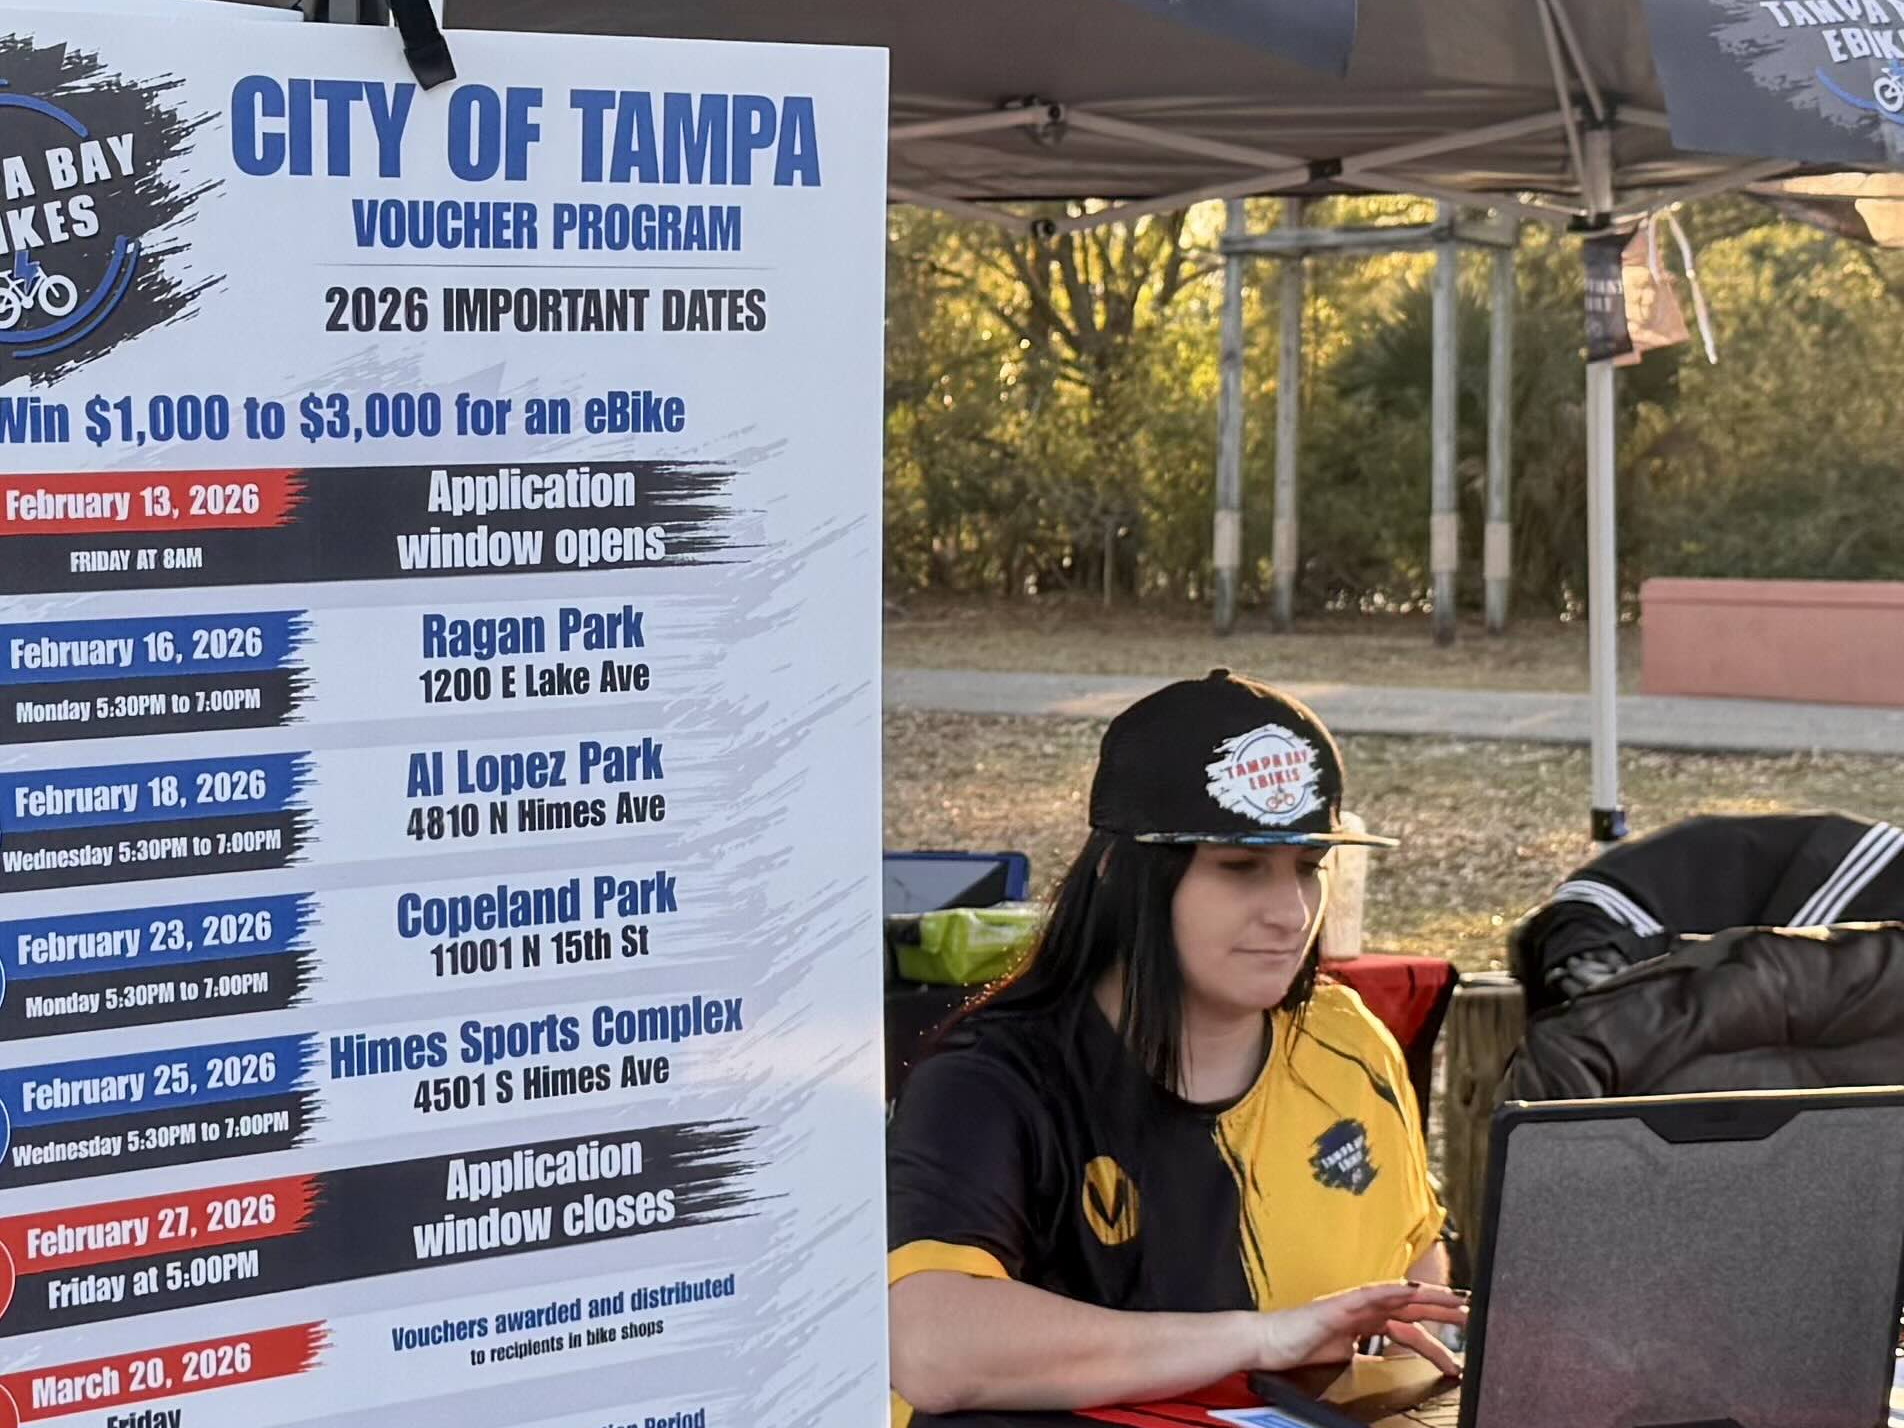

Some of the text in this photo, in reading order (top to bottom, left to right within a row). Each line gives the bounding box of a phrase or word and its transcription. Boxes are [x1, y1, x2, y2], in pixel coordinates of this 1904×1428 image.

[231, 74, 822, 187] CITY OF TAMPA
[45, 134, 135, 191] BAY
[352, 198, 742, 252] VOUCHER PROGRAM
[324, 286, 767, 333] 2026 IMPORTANT DATES
[83, 394, 230, 448] $1,000
[242, 395, 286, 441] to
[299, 390, 438, 444] $3,000
[454, 391, 513, 436] for
[524, 397, 571, 435] an
[584, 389, 686, 435] eBike
[6, 483, 260, 523] February 13, 2026
[427, 468, 635, 516] Application
[69, 547, 203, 573] FRIDAY AT 8AM
[397, 524, 666, 571] window opens
[10, 627, 263, 672] February 16, 2026
[423, 604, 645, 661] Ragan Park
[16, 688, 261, 725] Monday 5:30PM to 7:00PM
[419, 660, 651, 704] 1200 E Lake Ave
[406, 737, 665, 798] Al Lopez Park
[406, 790, 666, 842] 4810 N Himes Ave
[446, 1140, 644, 1203] Application
[413, 1187, 676, 1260] window closes
[391, 1274, 736, 1352] Vouchers awarded and distributed
[469, 1317, 665, 1367] to recipients in bike shops
